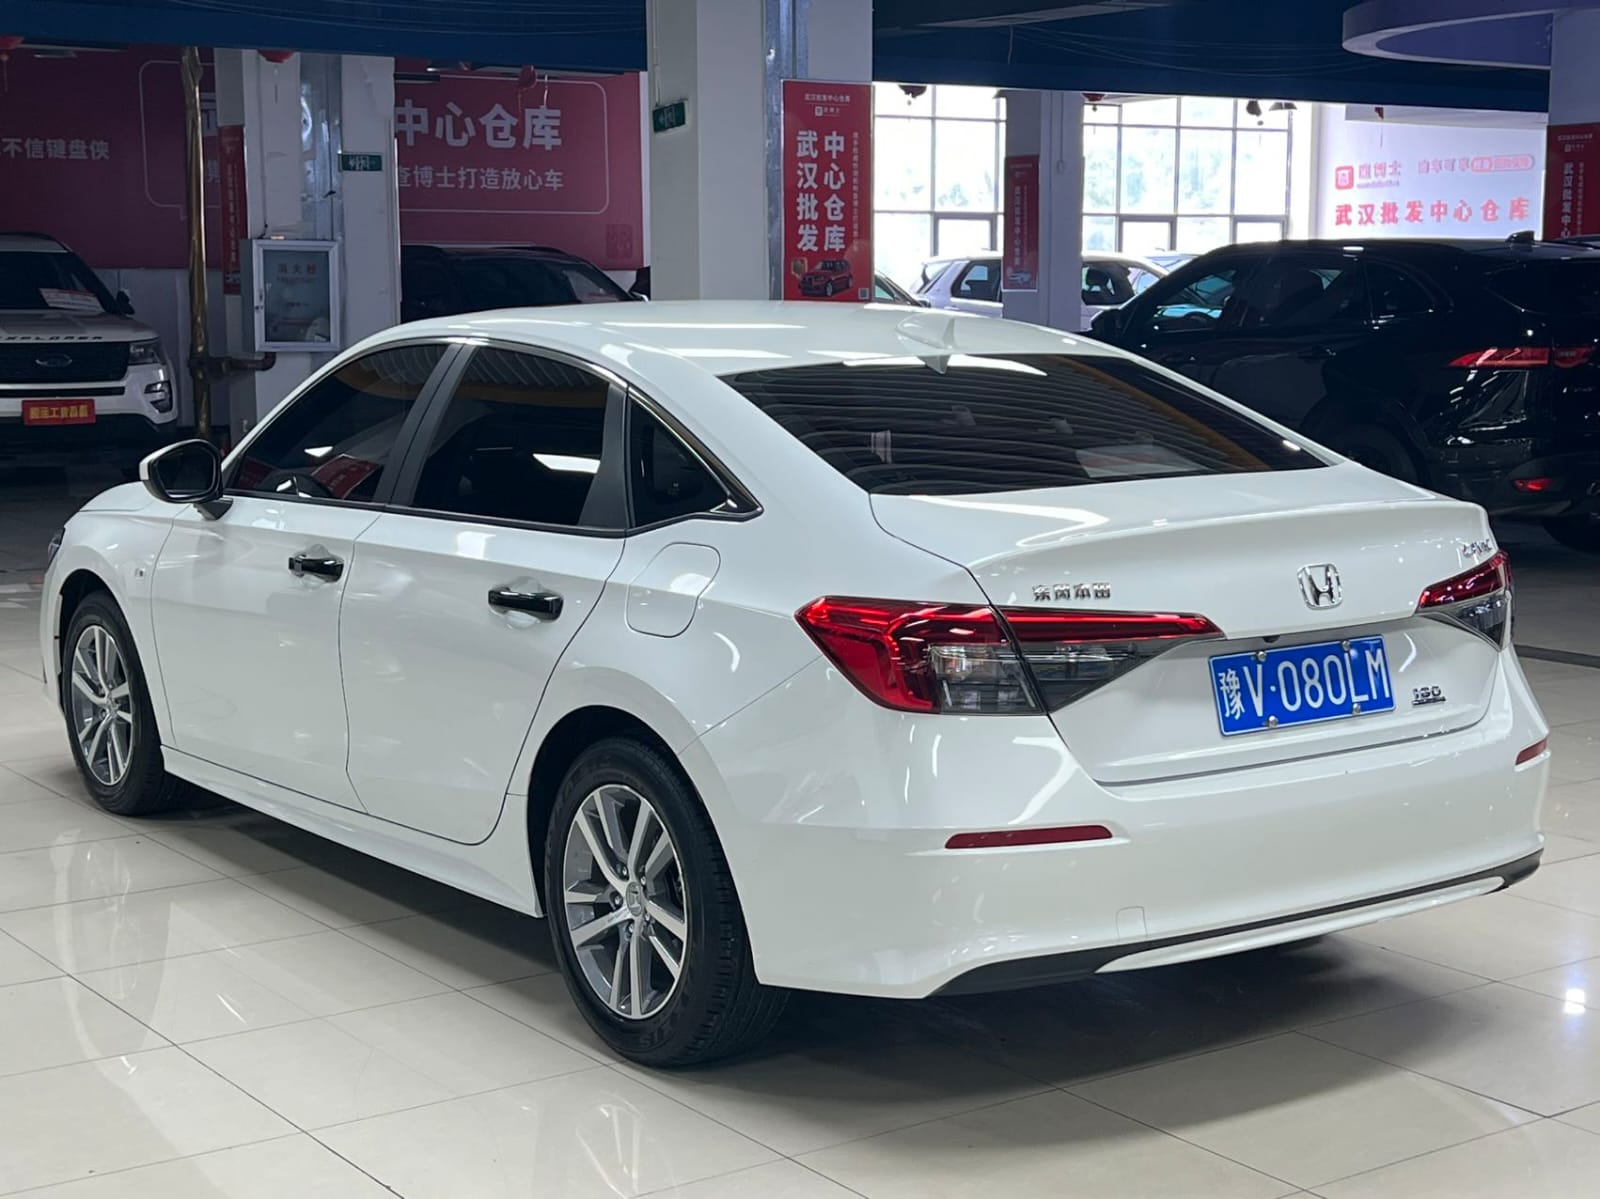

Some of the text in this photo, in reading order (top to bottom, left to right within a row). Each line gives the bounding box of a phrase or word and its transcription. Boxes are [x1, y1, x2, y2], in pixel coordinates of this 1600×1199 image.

[395, 99, 563, 150] 中心仓库
[1, 137, 110, 160] 不信键盘侠
[399, 166, 564, 191] 查博士打造放心车
[796, 130, 819, 252] 武汉批发
[823, 131, 846, 252] 中心仓库
[1334, 196, 1530, 226] 武汉批发中心仓库
